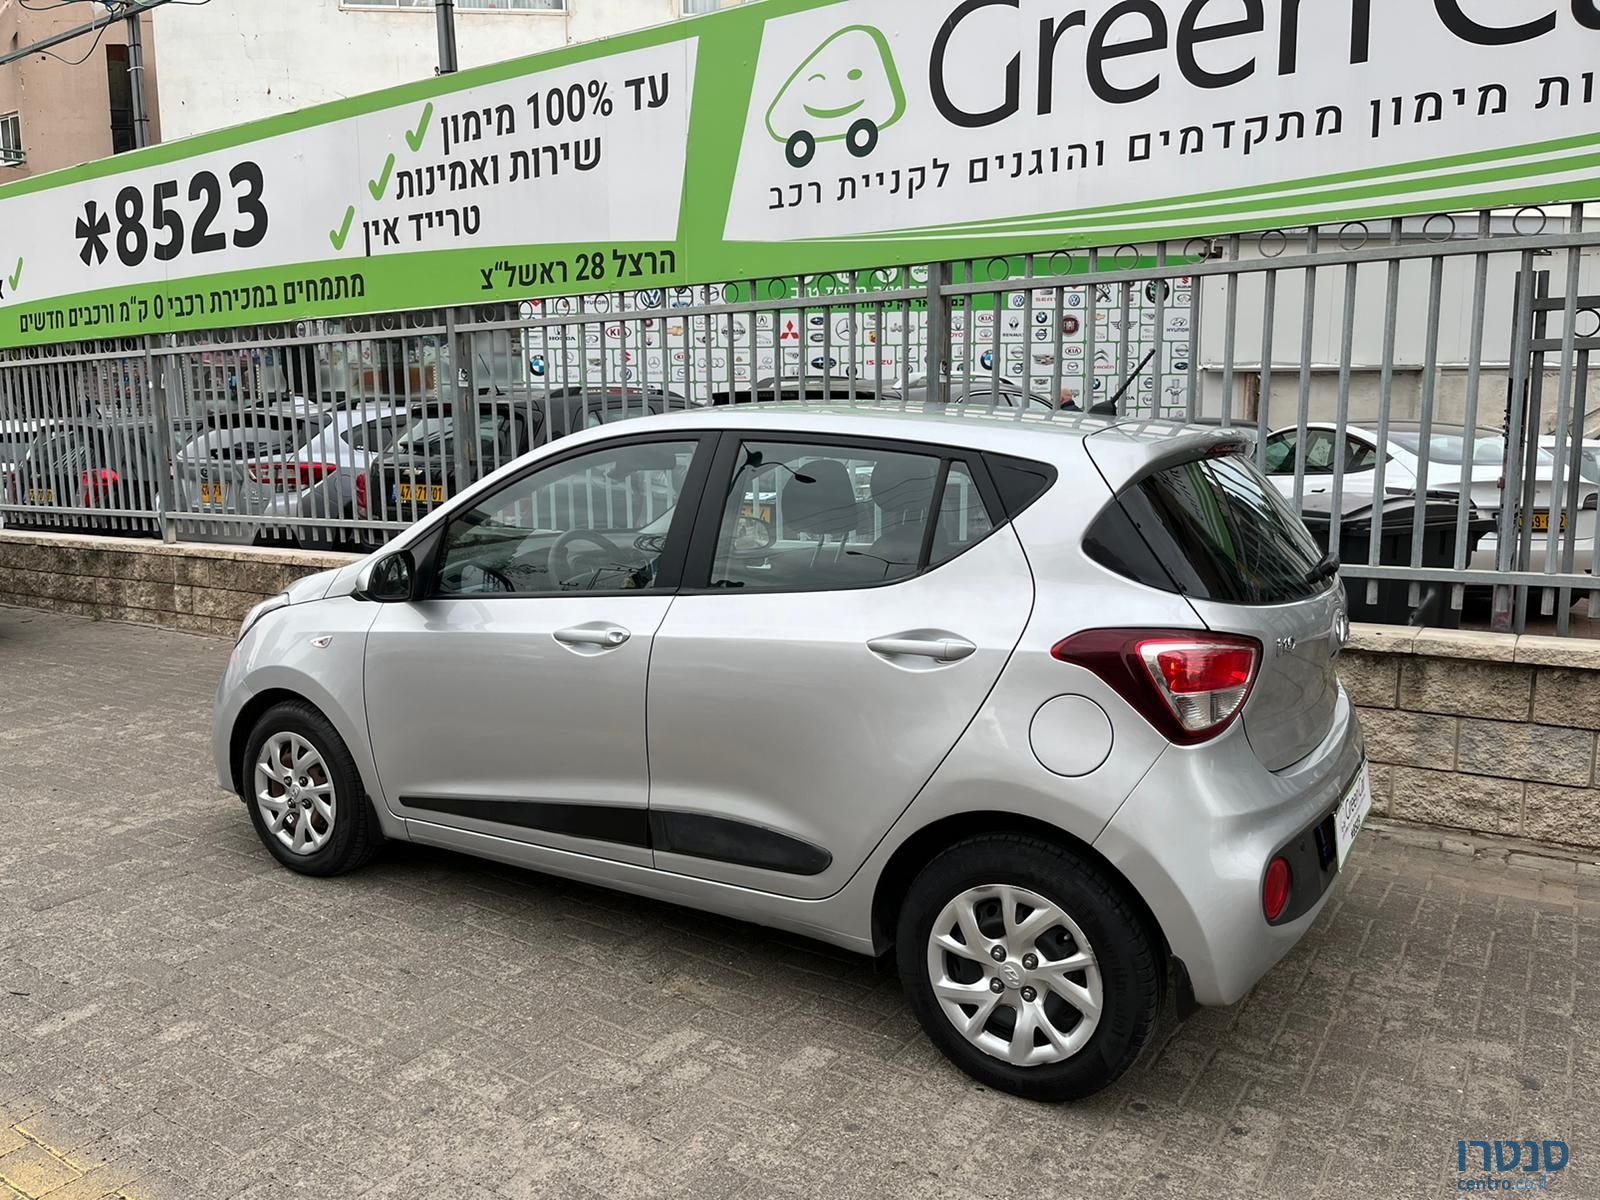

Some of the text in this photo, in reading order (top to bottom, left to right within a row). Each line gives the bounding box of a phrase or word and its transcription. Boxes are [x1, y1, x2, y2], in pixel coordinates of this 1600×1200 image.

[440, 72, 669, 155] עד 100% מימון
[1370, 83, 1507, 137] מימון
[1128, 105, 1342, 162] מתקדמים
[396, 136, 601, 200] שירות ואמינות
[969, 140, 1104, 184] והוגנים
[836, 157, 950, 200] לקניית
[768, 181, 821, 210] רכב
[362, 205, 481, 258] טרייד אין
[575, 252, 605, 282] 28
[612, 248, 676, 278] הרצל
[209, 284, 278, 314] במכירת
[283, 273, 365, 305] מתמחים
[19, 310, 65, 333] חדשים
[68, 303, 115, 328] ורכבים
[167, 293, 205, 318] רכבי
